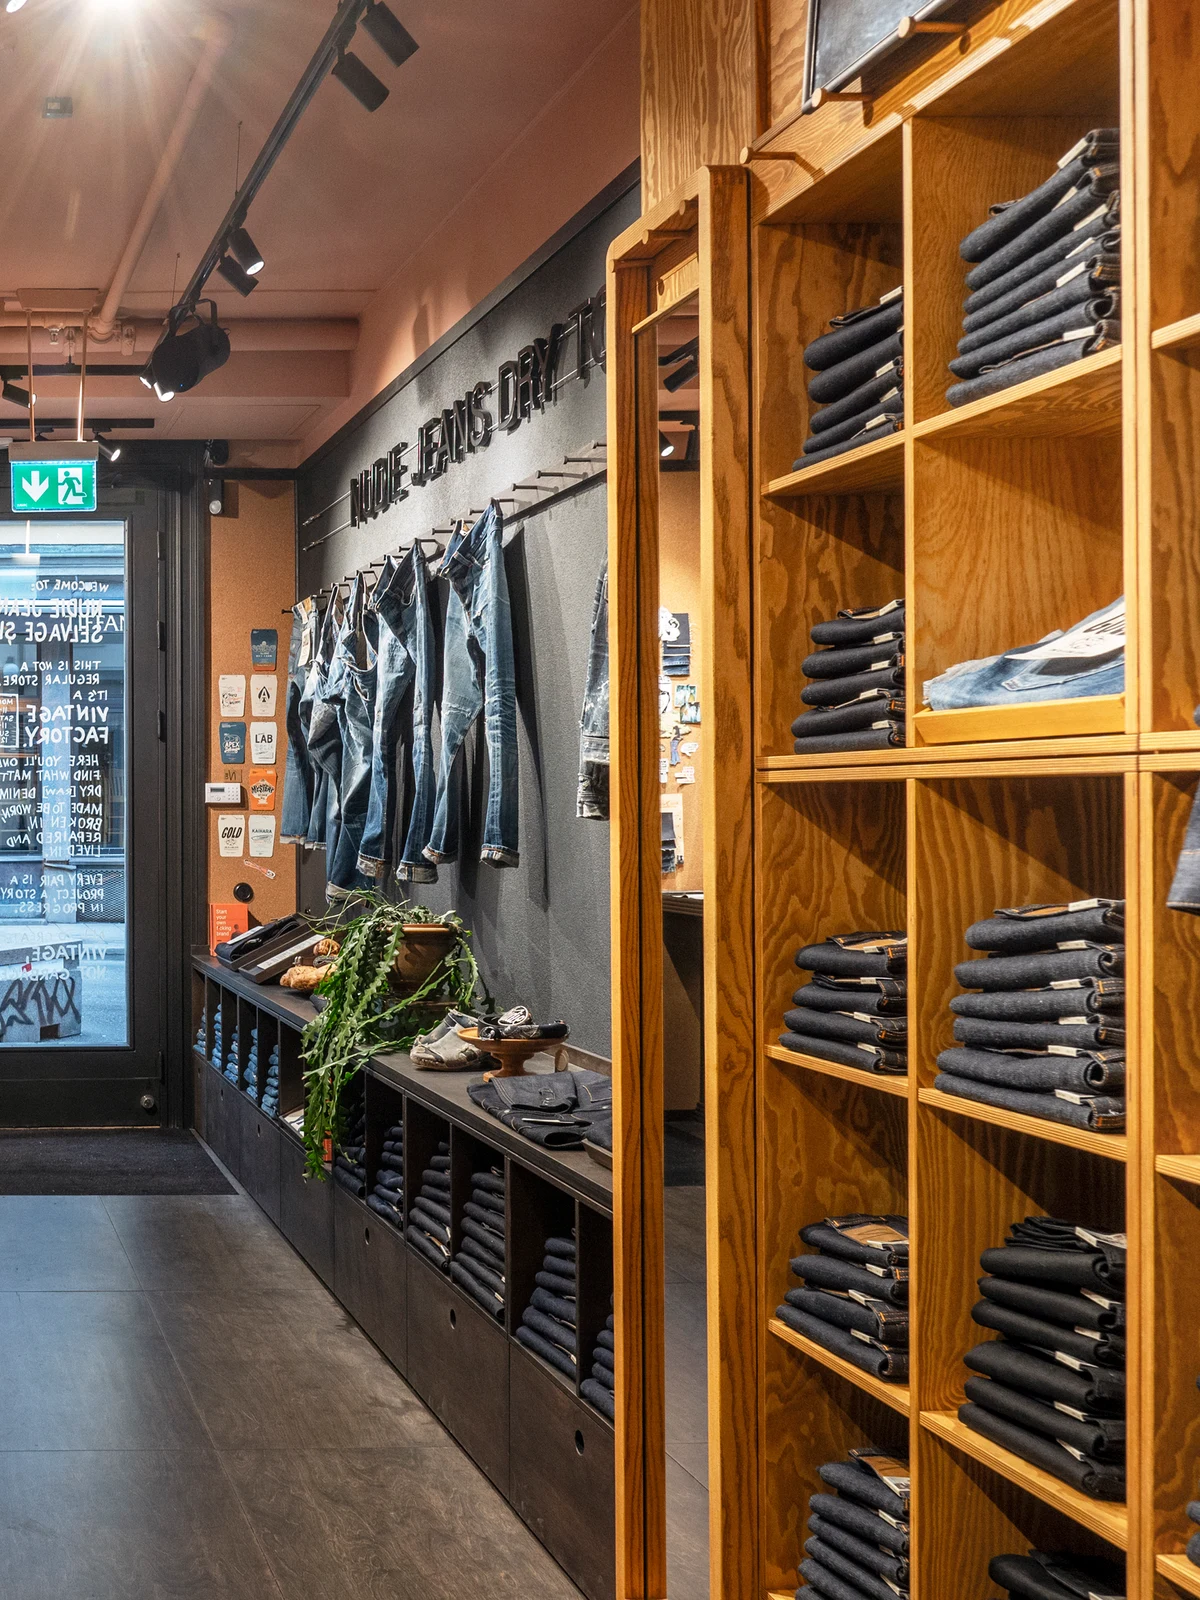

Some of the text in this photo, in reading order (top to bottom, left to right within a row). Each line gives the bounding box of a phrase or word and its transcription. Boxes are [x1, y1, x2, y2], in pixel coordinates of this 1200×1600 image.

[350, 442, 408, 527] NUDIE
[411, 381, 492, 486] JEANS
[499, 323, 563, 431] DRY
[255, 734, 273, 743] LAB
[221, 826, 243, 839] GOLD
